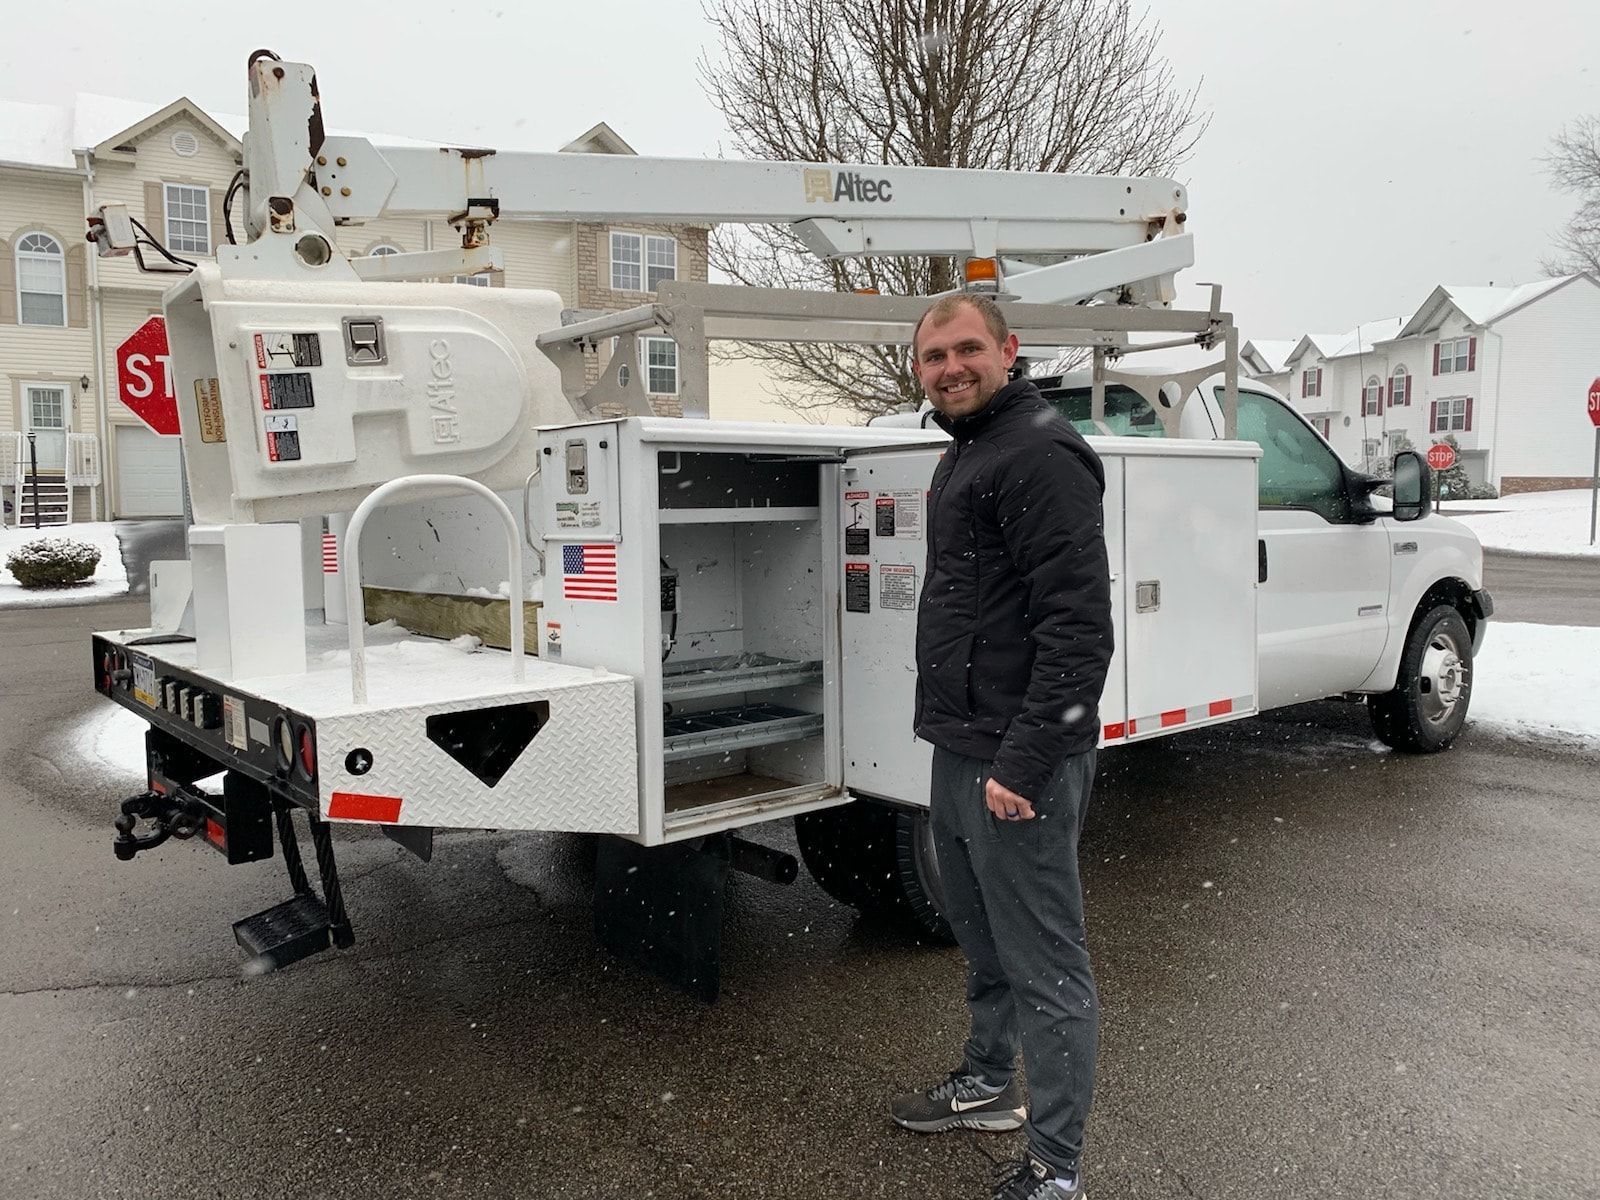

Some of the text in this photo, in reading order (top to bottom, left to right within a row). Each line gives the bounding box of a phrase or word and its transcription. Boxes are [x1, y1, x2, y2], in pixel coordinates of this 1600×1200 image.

[834, 172, 893, 202] Altec
[255, 335, 265, 362] DANGER
[428, 338, 457, 414] Altec
[202, 396, 214, 435] PLATFORM
[209, 380, 222, 441] NON-INSULATING
[1429, 451, 1453, 462] STOP
